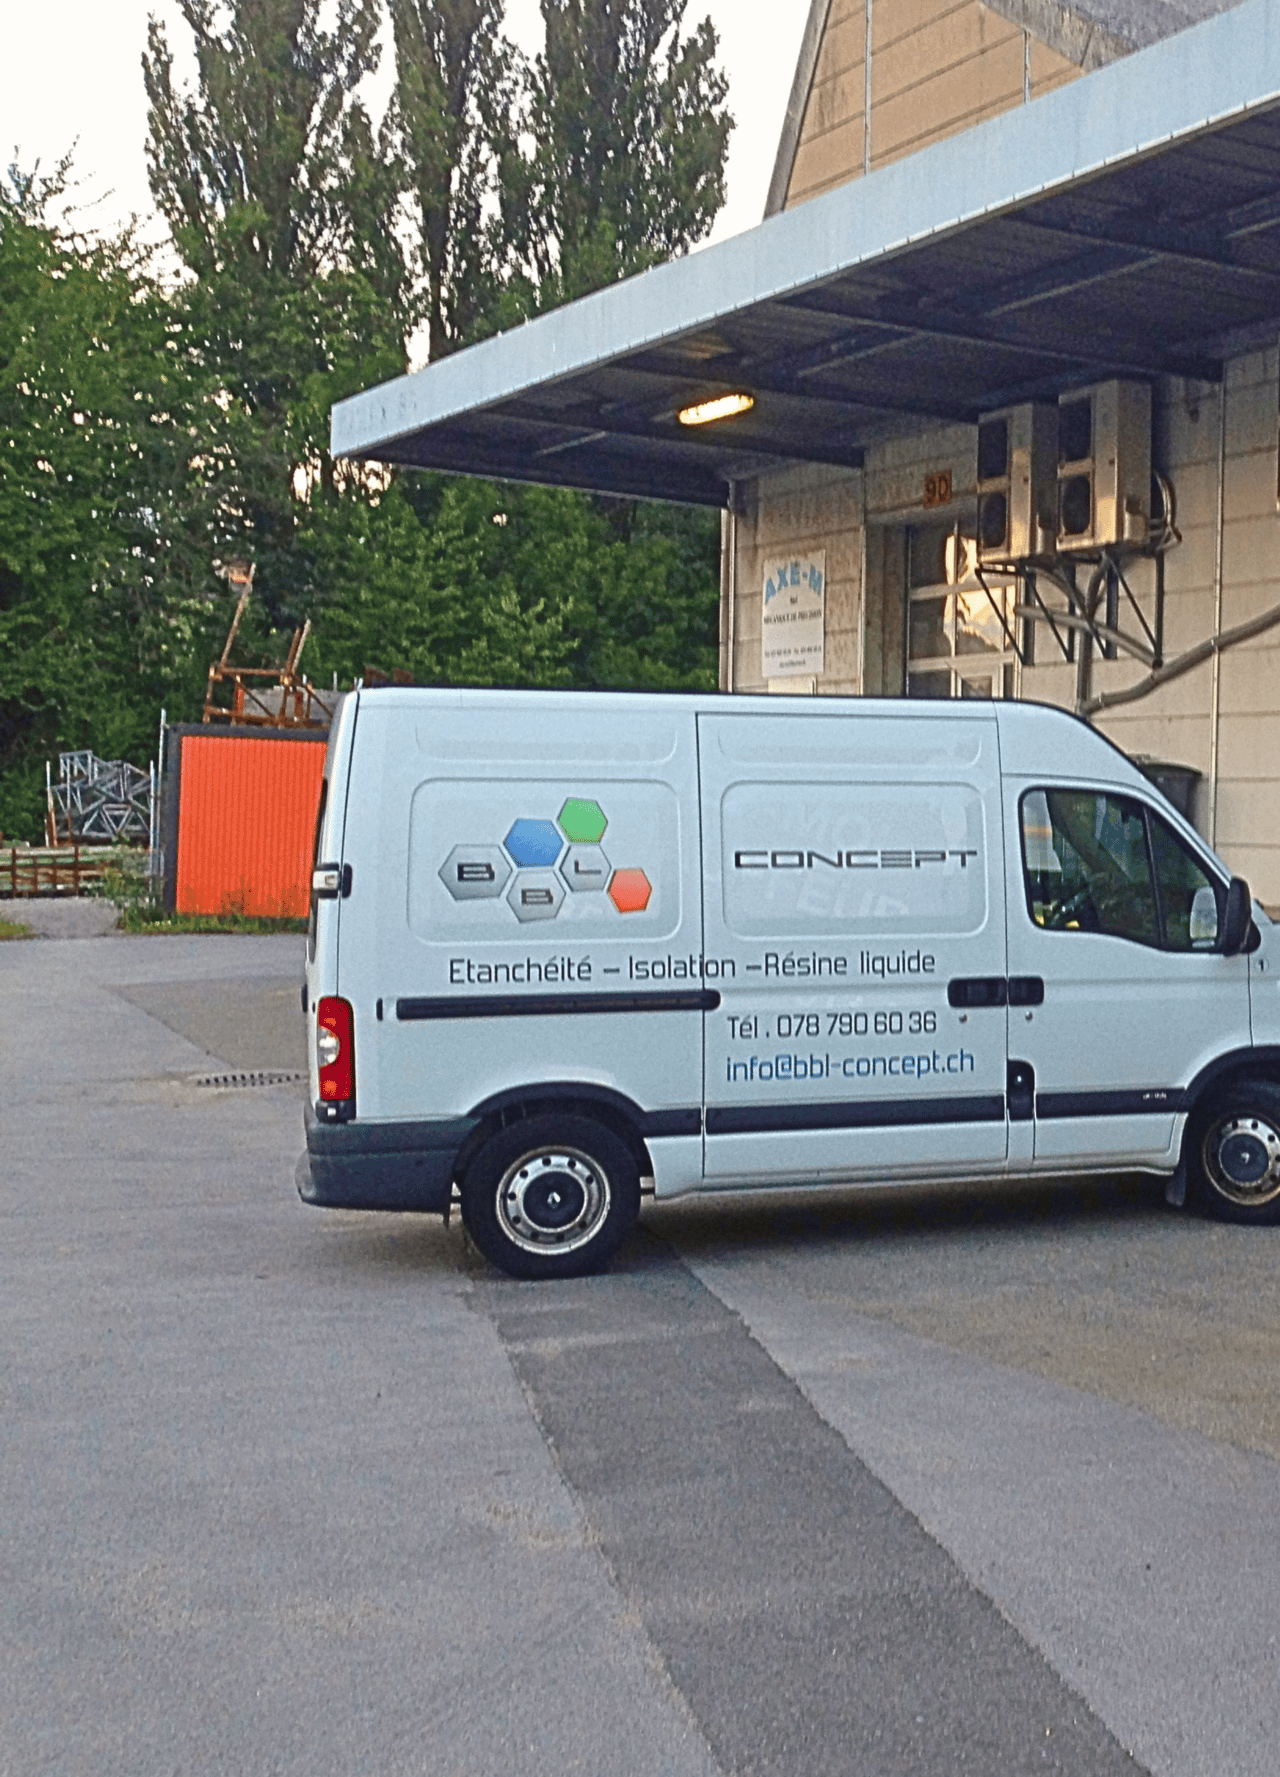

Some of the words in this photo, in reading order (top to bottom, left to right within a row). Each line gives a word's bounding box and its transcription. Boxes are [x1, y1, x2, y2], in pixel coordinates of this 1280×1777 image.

[734, 849, 978, 869] CONCEPT
[449, 955, 592, 984] Etanchéité
[629, 953, 736, 980] Isolation
[860, 949, 935, 979] liquide
[777, 1013, 820, 1038] 078
[827, 1011, 868, 1036] 790
[874, 1010, 903, 1035] 60
[908, 1009, 937, 1034] 36
[726, 1048, 975, 1082] info@bbl-concept.ch
